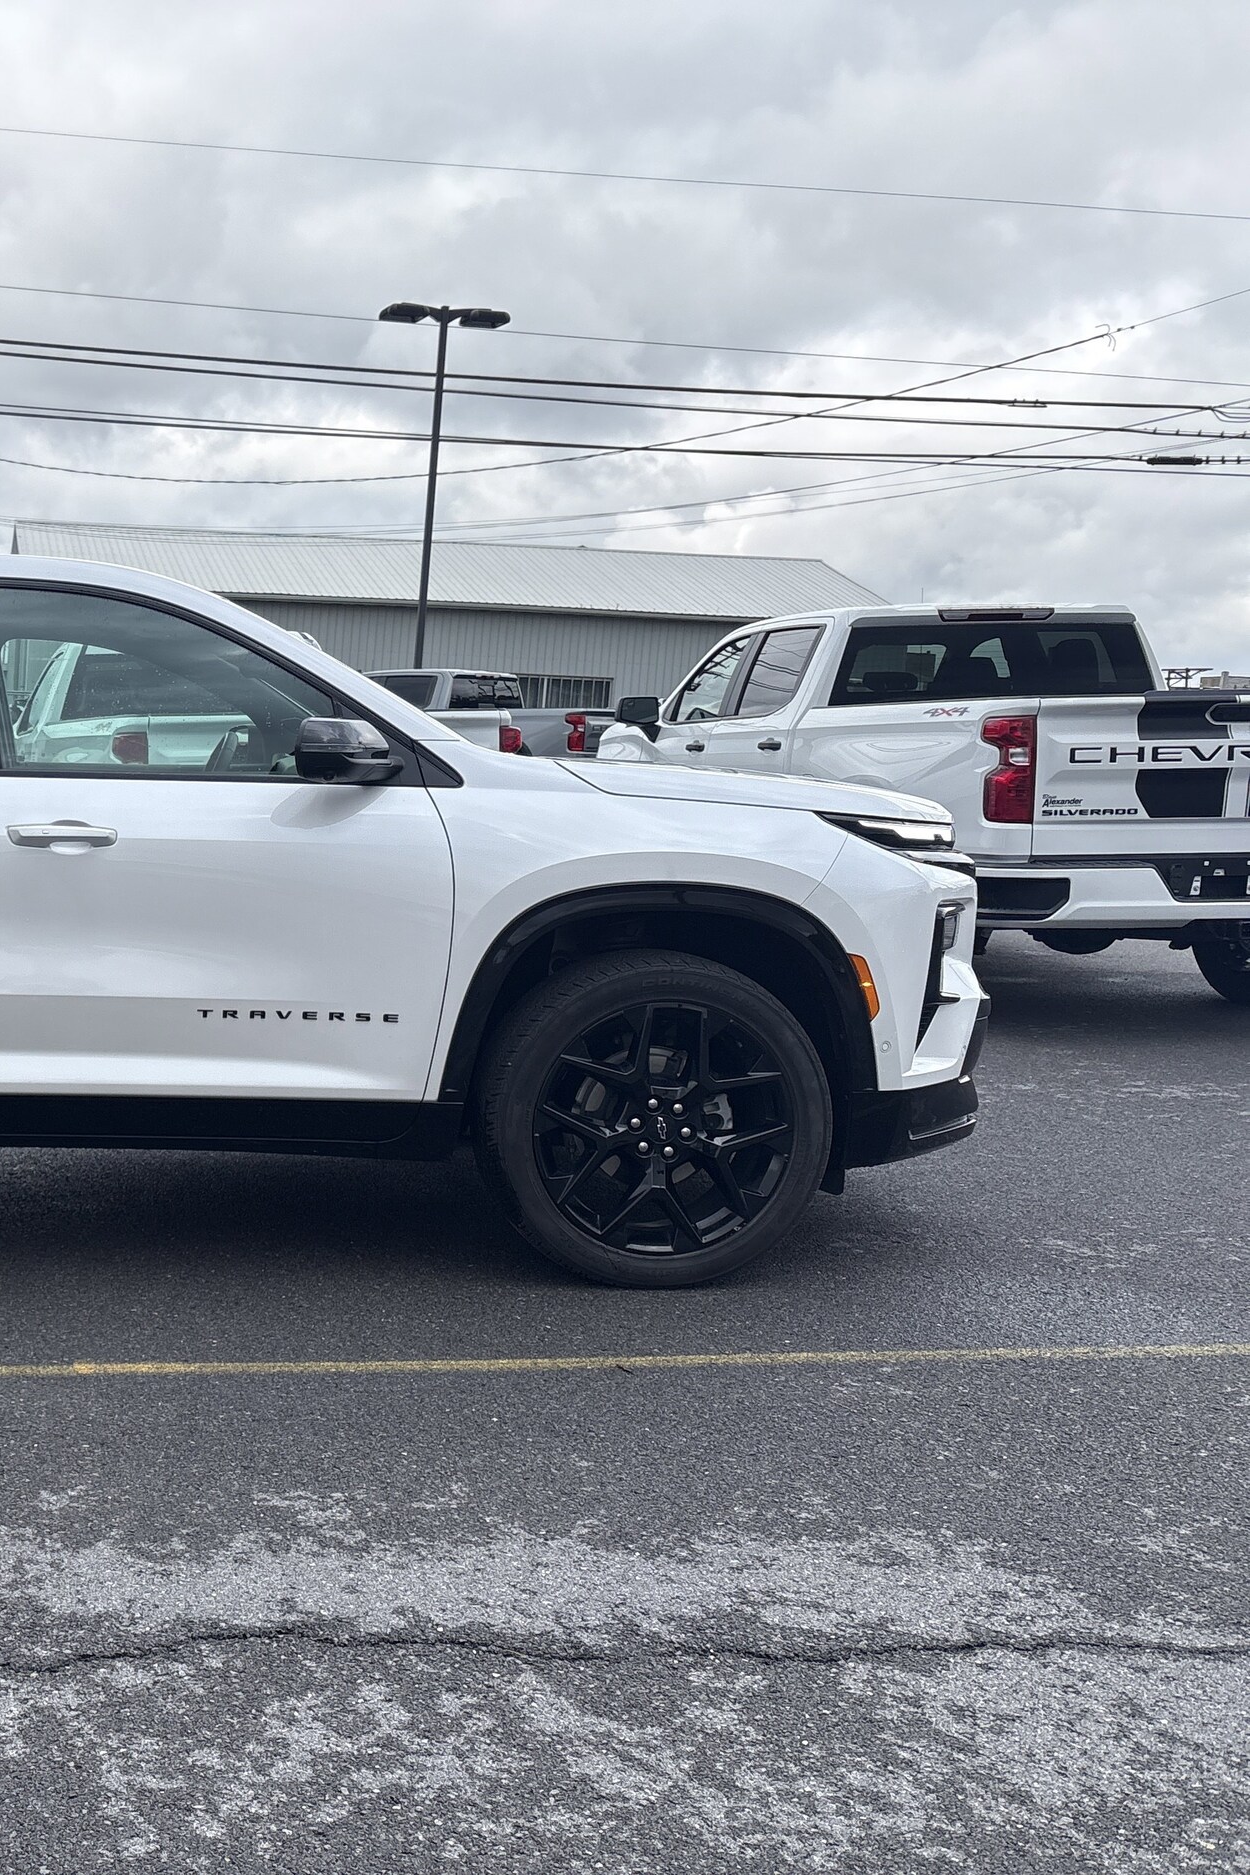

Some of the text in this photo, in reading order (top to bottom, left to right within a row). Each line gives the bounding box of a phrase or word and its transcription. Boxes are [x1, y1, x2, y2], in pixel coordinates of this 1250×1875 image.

[1042, 798, 1083, 807] Alexander
[1041, 808, 1138, 816] SILVERADO
[197, 1009, 399, 1023] TRAVERSE
